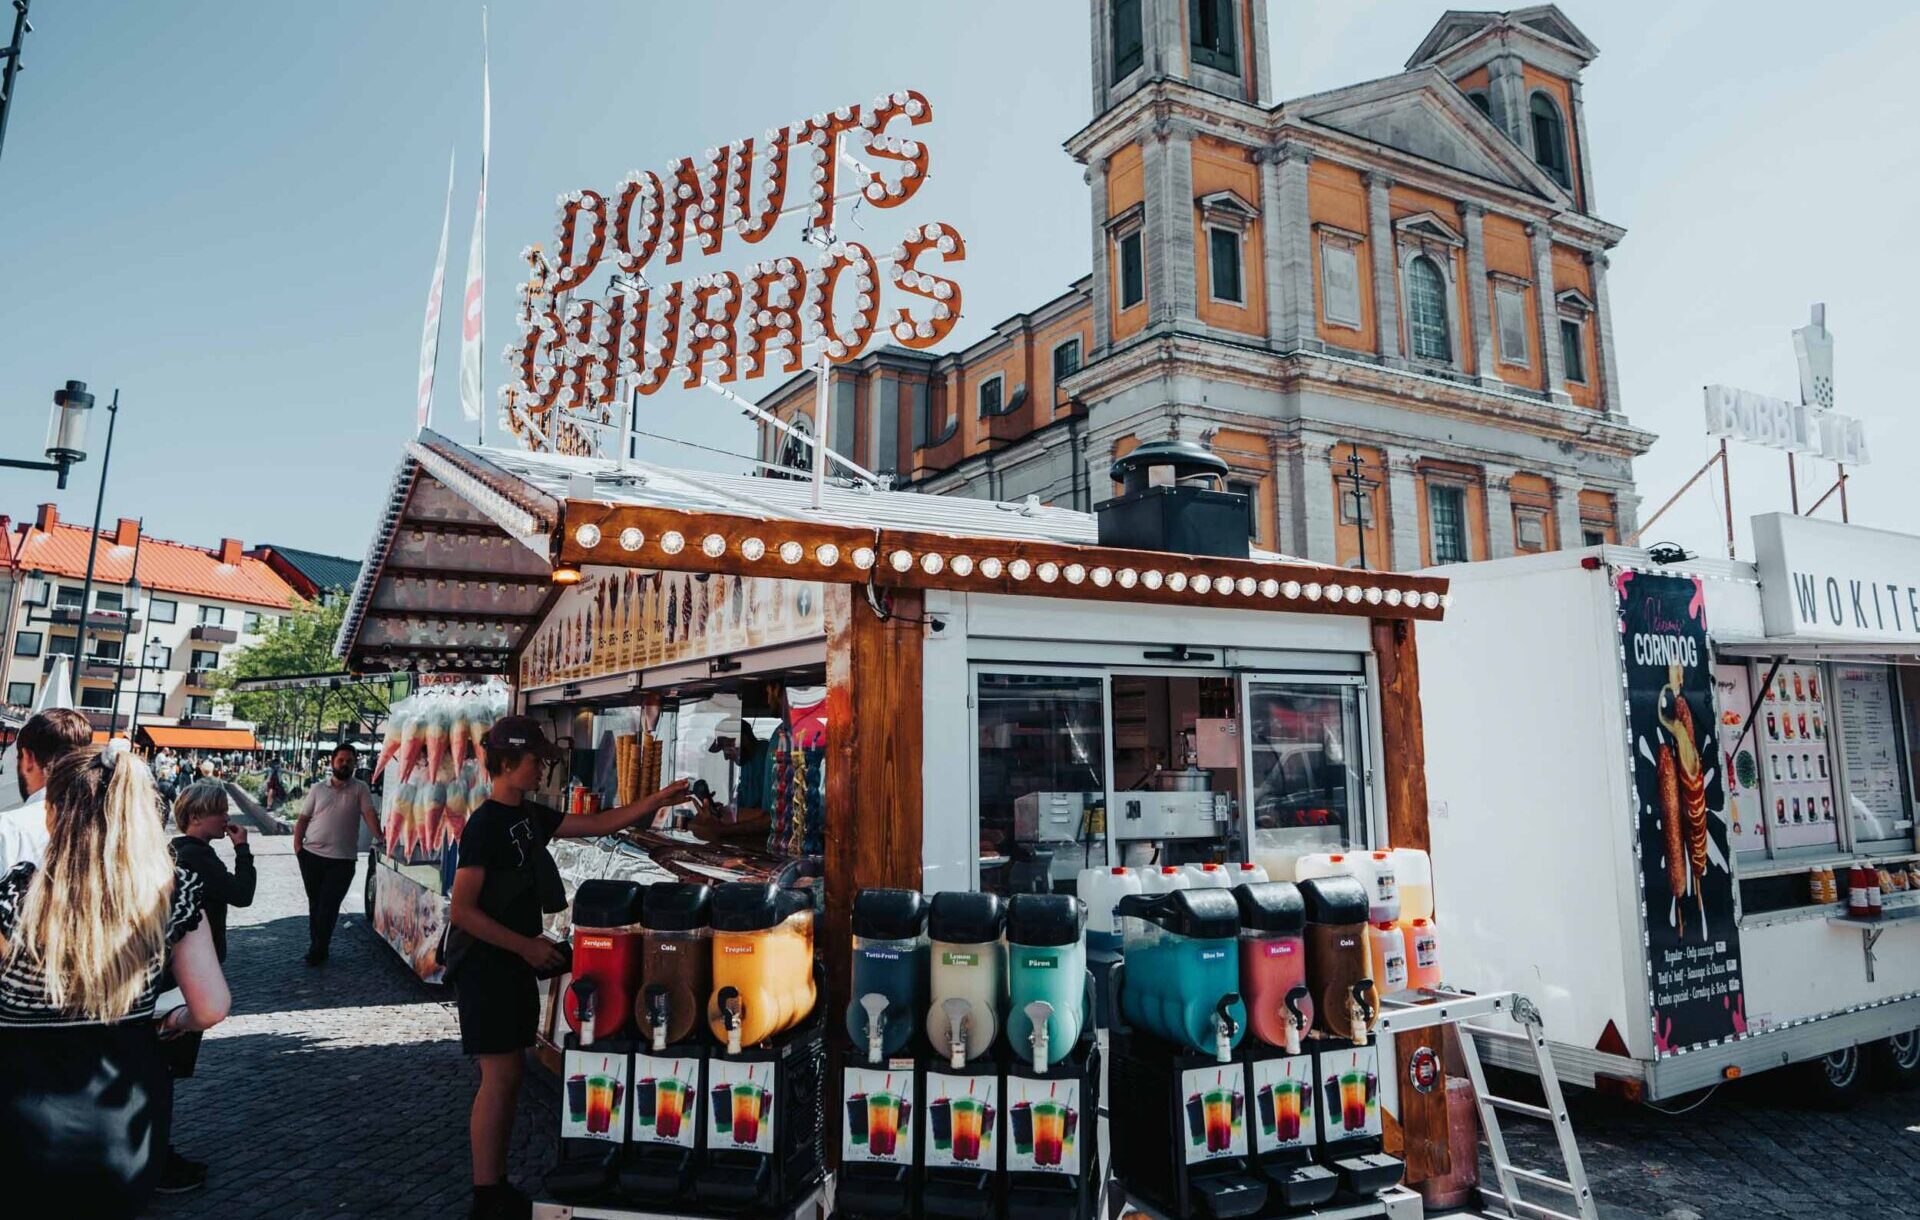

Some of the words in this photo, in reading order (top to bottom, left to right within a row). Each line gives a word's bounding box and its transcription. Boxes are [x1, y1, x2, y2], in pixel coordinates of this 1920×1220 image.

[553, 89, 933, 293] DONUTS
[514, 222, 966, 413] CHURROS
[1633, 632, 1698, 667] CORNDOG
[724, 946, 752, 954] Tropical
[1340, 939, 1355, 947] Cola
[865, 952, 899, 960] Tutti-Frutti
